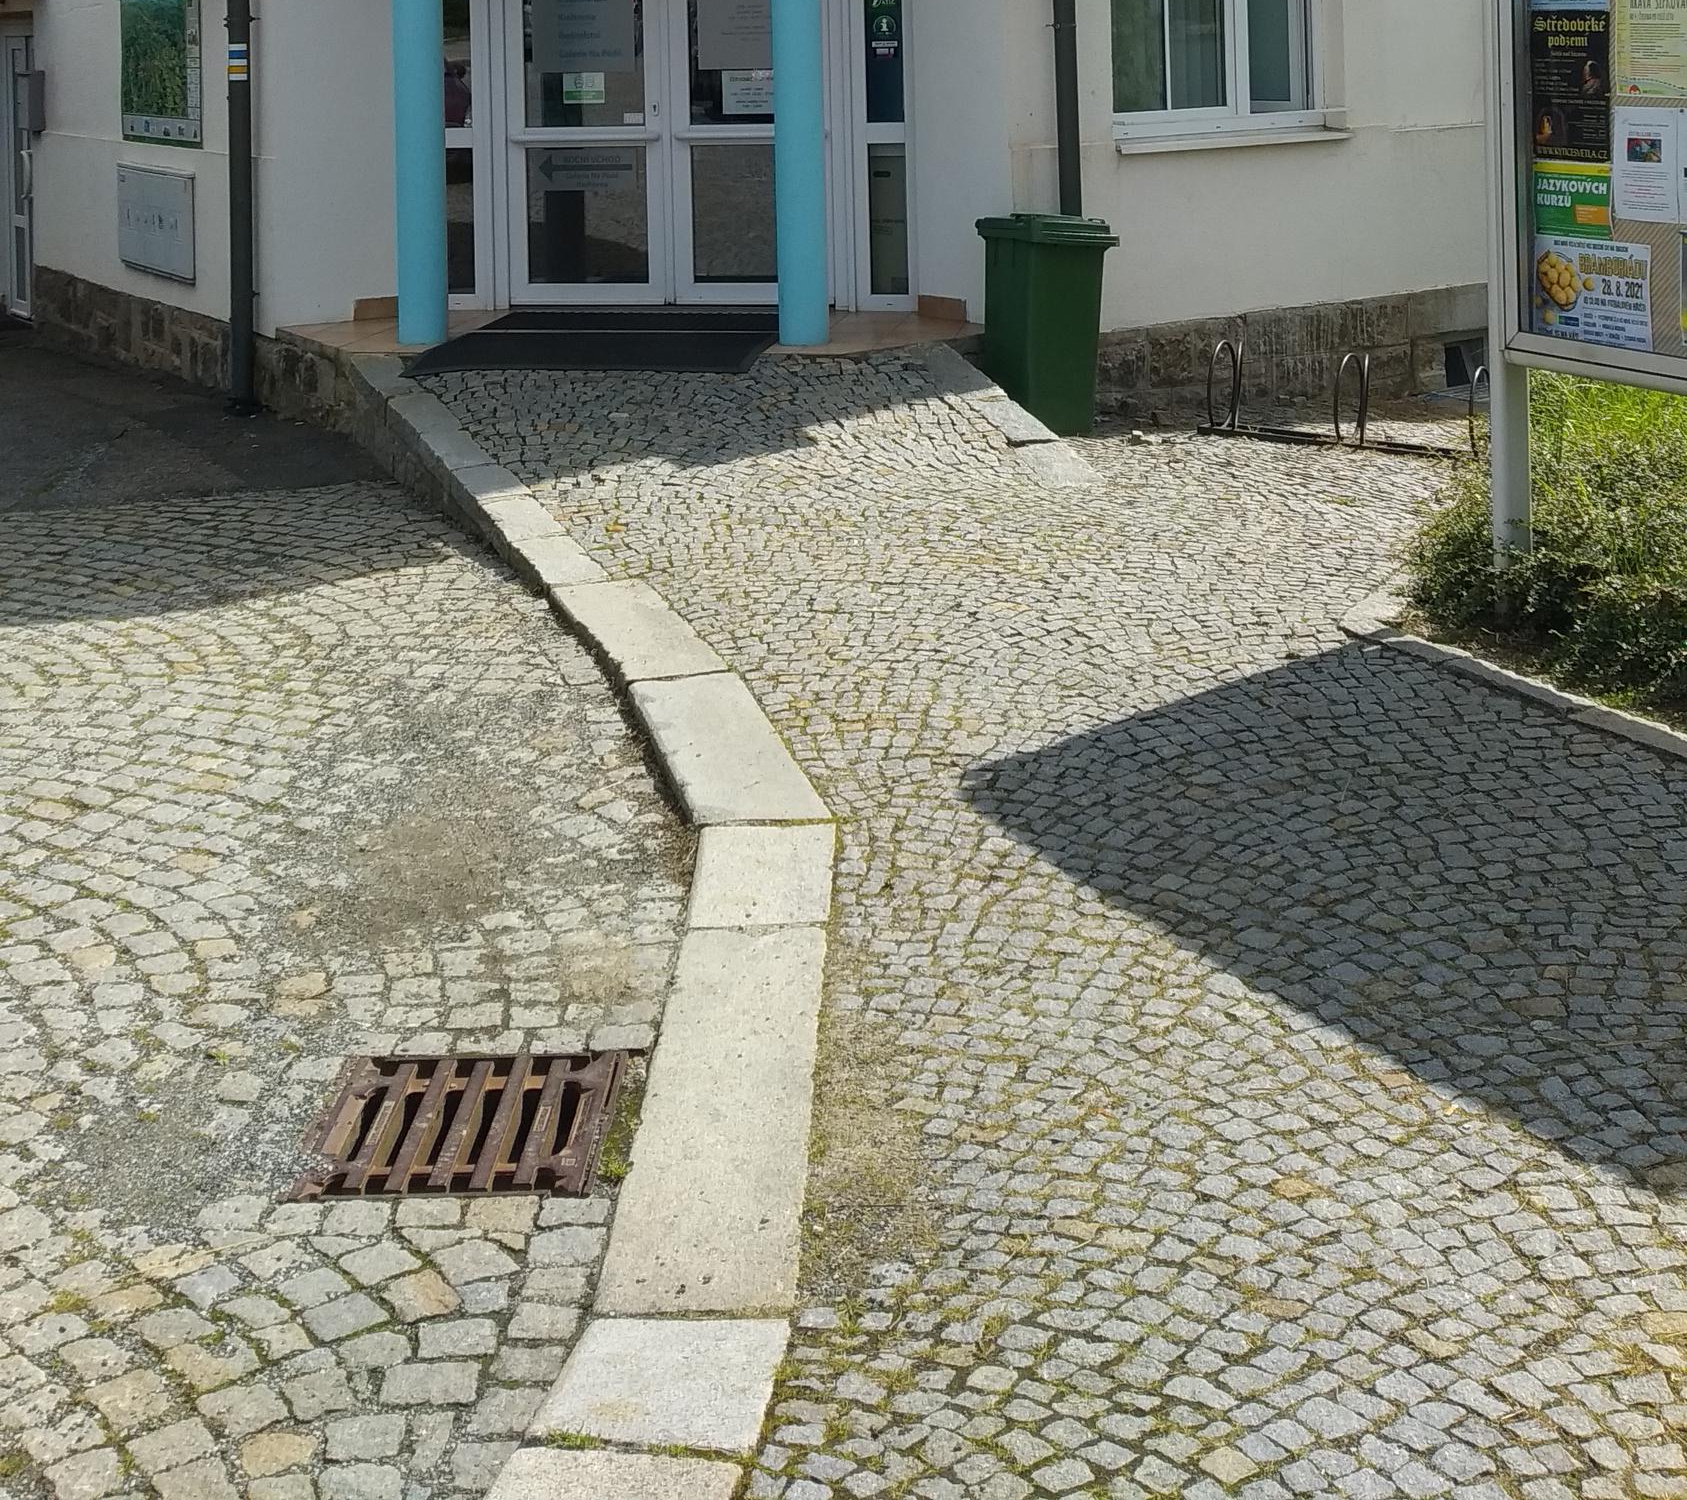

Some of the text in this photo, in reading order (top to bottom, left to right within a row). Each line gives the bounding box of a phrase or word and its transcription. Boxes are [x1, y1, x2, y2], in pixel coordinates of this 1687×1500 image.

[1533, 14, 1606, 32] Středověké
[1547, 32, 1588, 49] podzemí
[1537, 178, 1607, 195] JAZYKOVÝCH
[1537, 191, 1571, 207] KURZŮ
[1602, 278, 1643, 300] 28. 8. 2021
